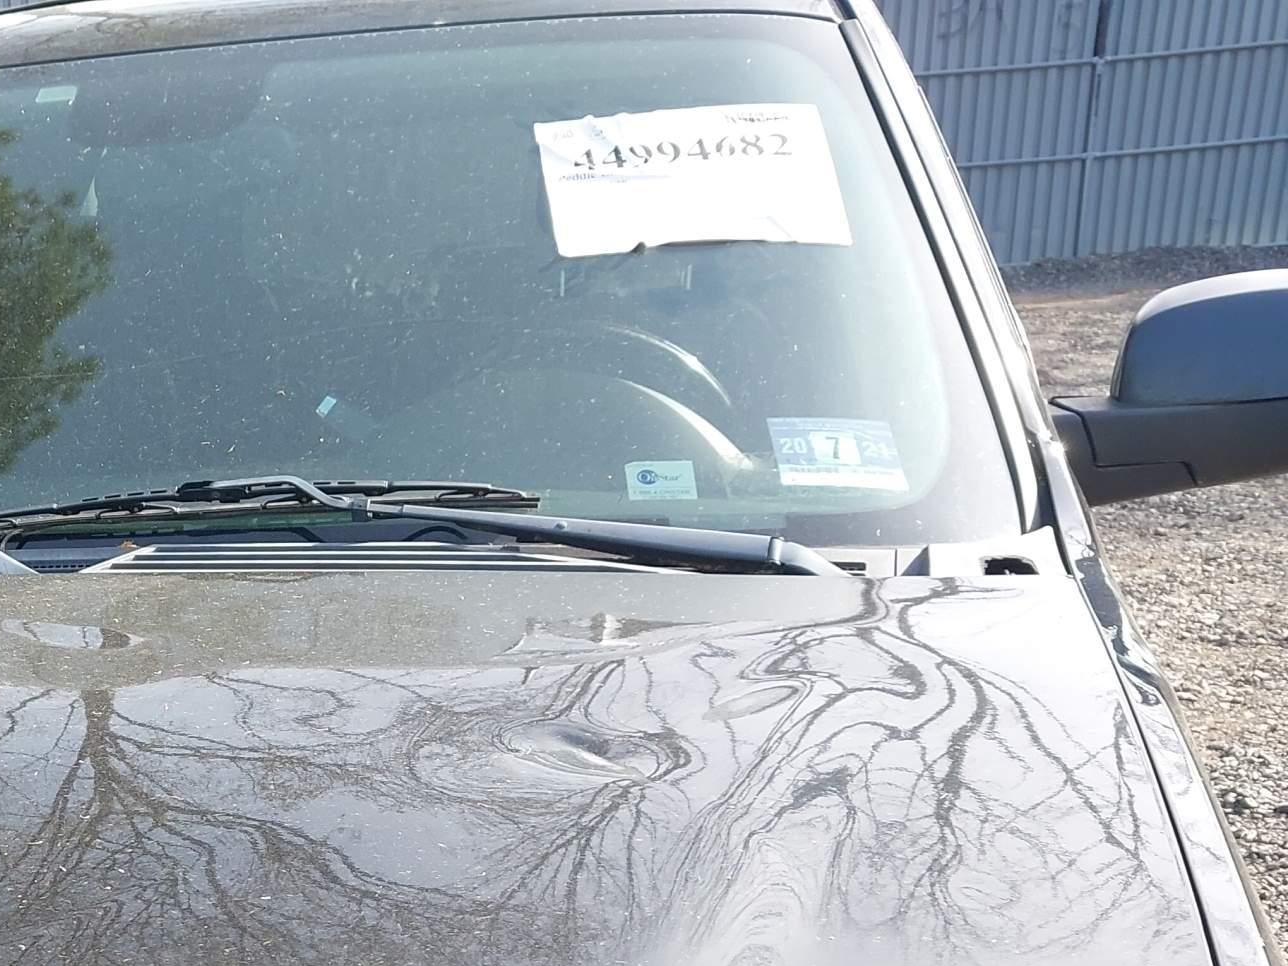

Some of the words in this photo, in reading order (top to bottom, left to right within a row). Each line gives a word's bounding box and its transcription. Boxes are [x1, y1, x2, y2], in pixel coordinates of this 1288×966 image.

[573, 132, 793, 171] 44994682
[779, 436, 808, 455] 20
[825, 436, 842, 460] 7
